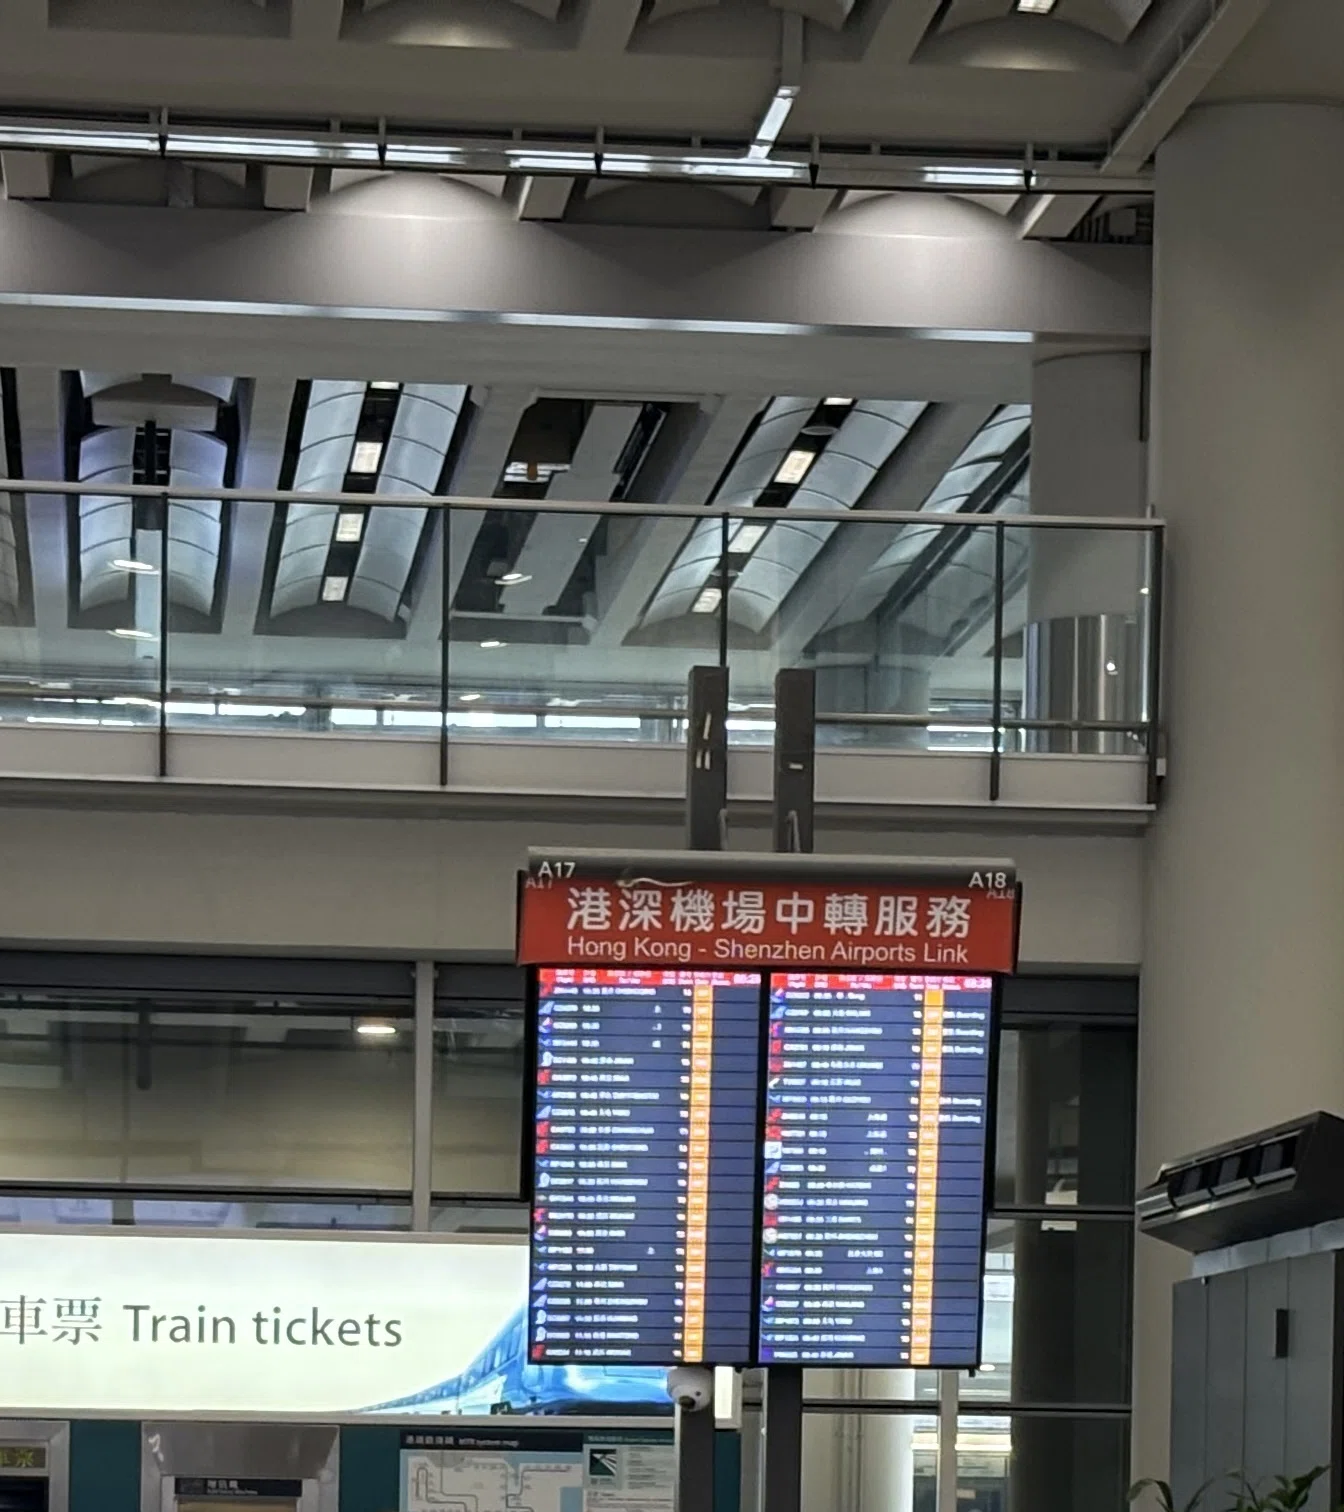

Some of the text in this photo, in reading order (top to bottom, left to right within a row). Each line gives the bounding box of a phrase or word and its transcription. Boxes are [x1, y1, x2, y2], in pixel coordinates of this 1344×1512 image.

[538, 861, 576, 878] A17
[968, 872, 1006, 890] A18
[567, 886, 972, 938] 港深機場中轉服務
[567, 938, 627, 963] Hong
[634, 939, 692, 963] Kong
[713, 939, 825, 961] Shenzhen
[831, 940, 915, 965] Airports
[924, 942, 968, 964] Link
[122, 1304, 236, 1345] Train
[253, 1305, 403, 1348] tickets
